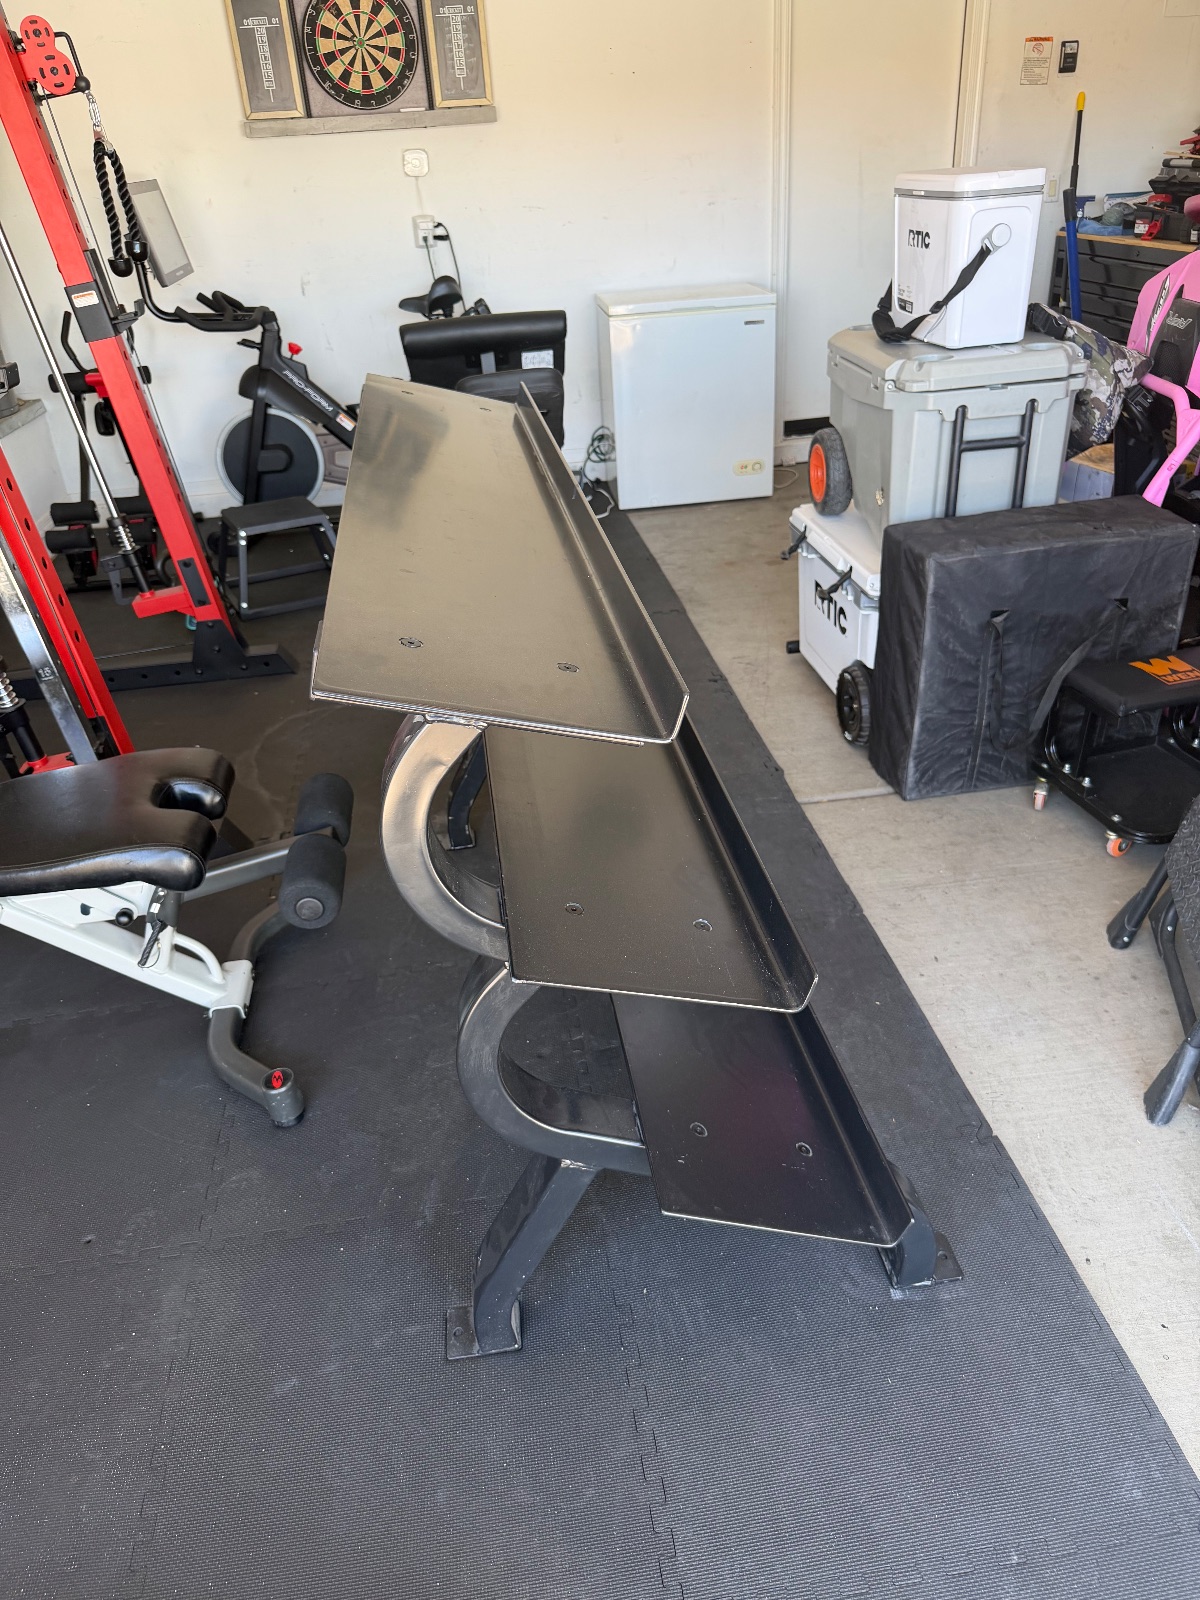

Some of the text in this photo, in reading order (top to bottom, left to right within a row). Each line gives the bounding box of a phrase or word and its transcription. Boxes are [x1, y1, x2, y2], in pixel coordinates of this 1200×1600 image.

[451, 15, 461, 23] 20
[256, 27, 266, 35] 20
[258, 36, 266, 44] 19
[259, 45, 268, 53] 18
[265, 71, 273, 79] 15
[907, 228, 931, 250] RTIC
